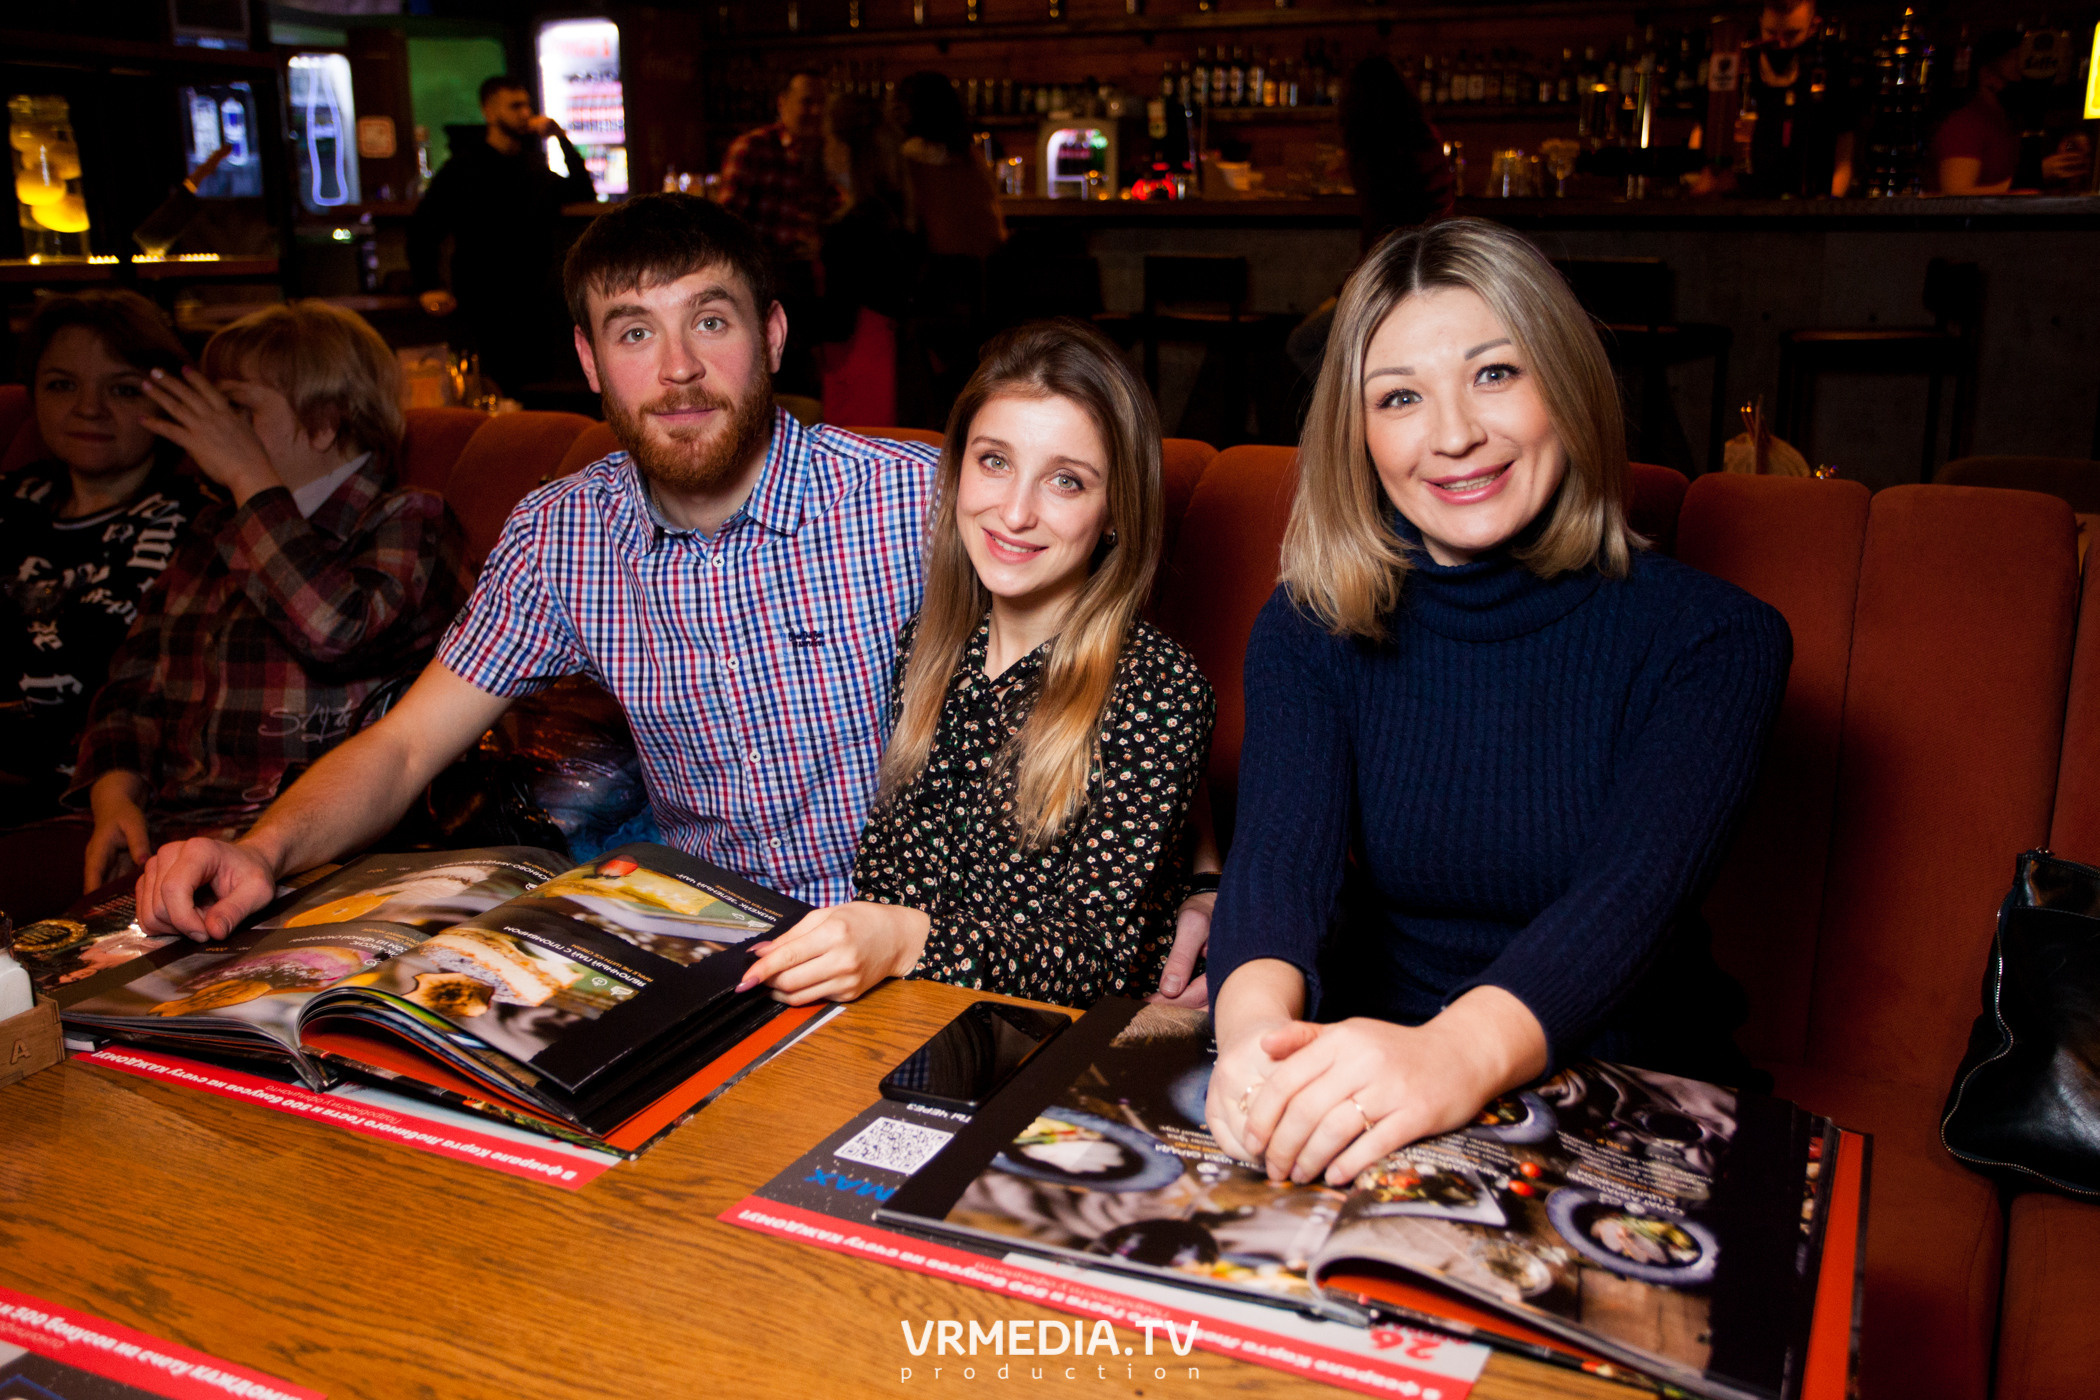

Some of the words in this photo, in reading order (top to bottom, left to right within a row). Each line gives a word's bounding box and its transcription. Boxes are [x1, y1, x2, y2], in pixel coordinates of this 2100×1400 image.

[571, 950, 593, 962] ПАЙ
[591, 960, 646, 987] ЯБЛОЧНЫЙ
[10, 1040, 31, 1064] A
[90, 1046, 169, 1074] КАЖДОМУ!
[166, 1067, 208, 1084] счету
[207, 1079, 227, 1089] на
[225, 1083, 284, 1104] бонусов
[281, 1097, 312, 1111] 500
[309, 1104, 324, 1114] и
[319, 1107, 366, 1125] Гостя
[363, 1119, 444, 1145] Любимого
[440, 1138, 491, 1158] Карта
[490, 1151, 563, 1176] феврале
[561, 1169, 577, 1180] В
[739, 1210, 844, 1243] КАЖДОМУ!
[842, 1236, 899, 1257] счету
[899, 1252, 926, 1264] на
[925, 1259, 1000, 1287] бонусов
[1008, 1281, 1048, 1298] 500
[11, 1305, 48, 1325] 500
[44, 1316, 118, 1349] бонусов
[113, 1340, 142, 1358] на
[137, 1350, 193, 1377] счету
[1367, 1325, 1442, 1365] 26
[1241, 1341, 1313, 1368] Карта
[1314, 1360, 1420, 1396] феврале
